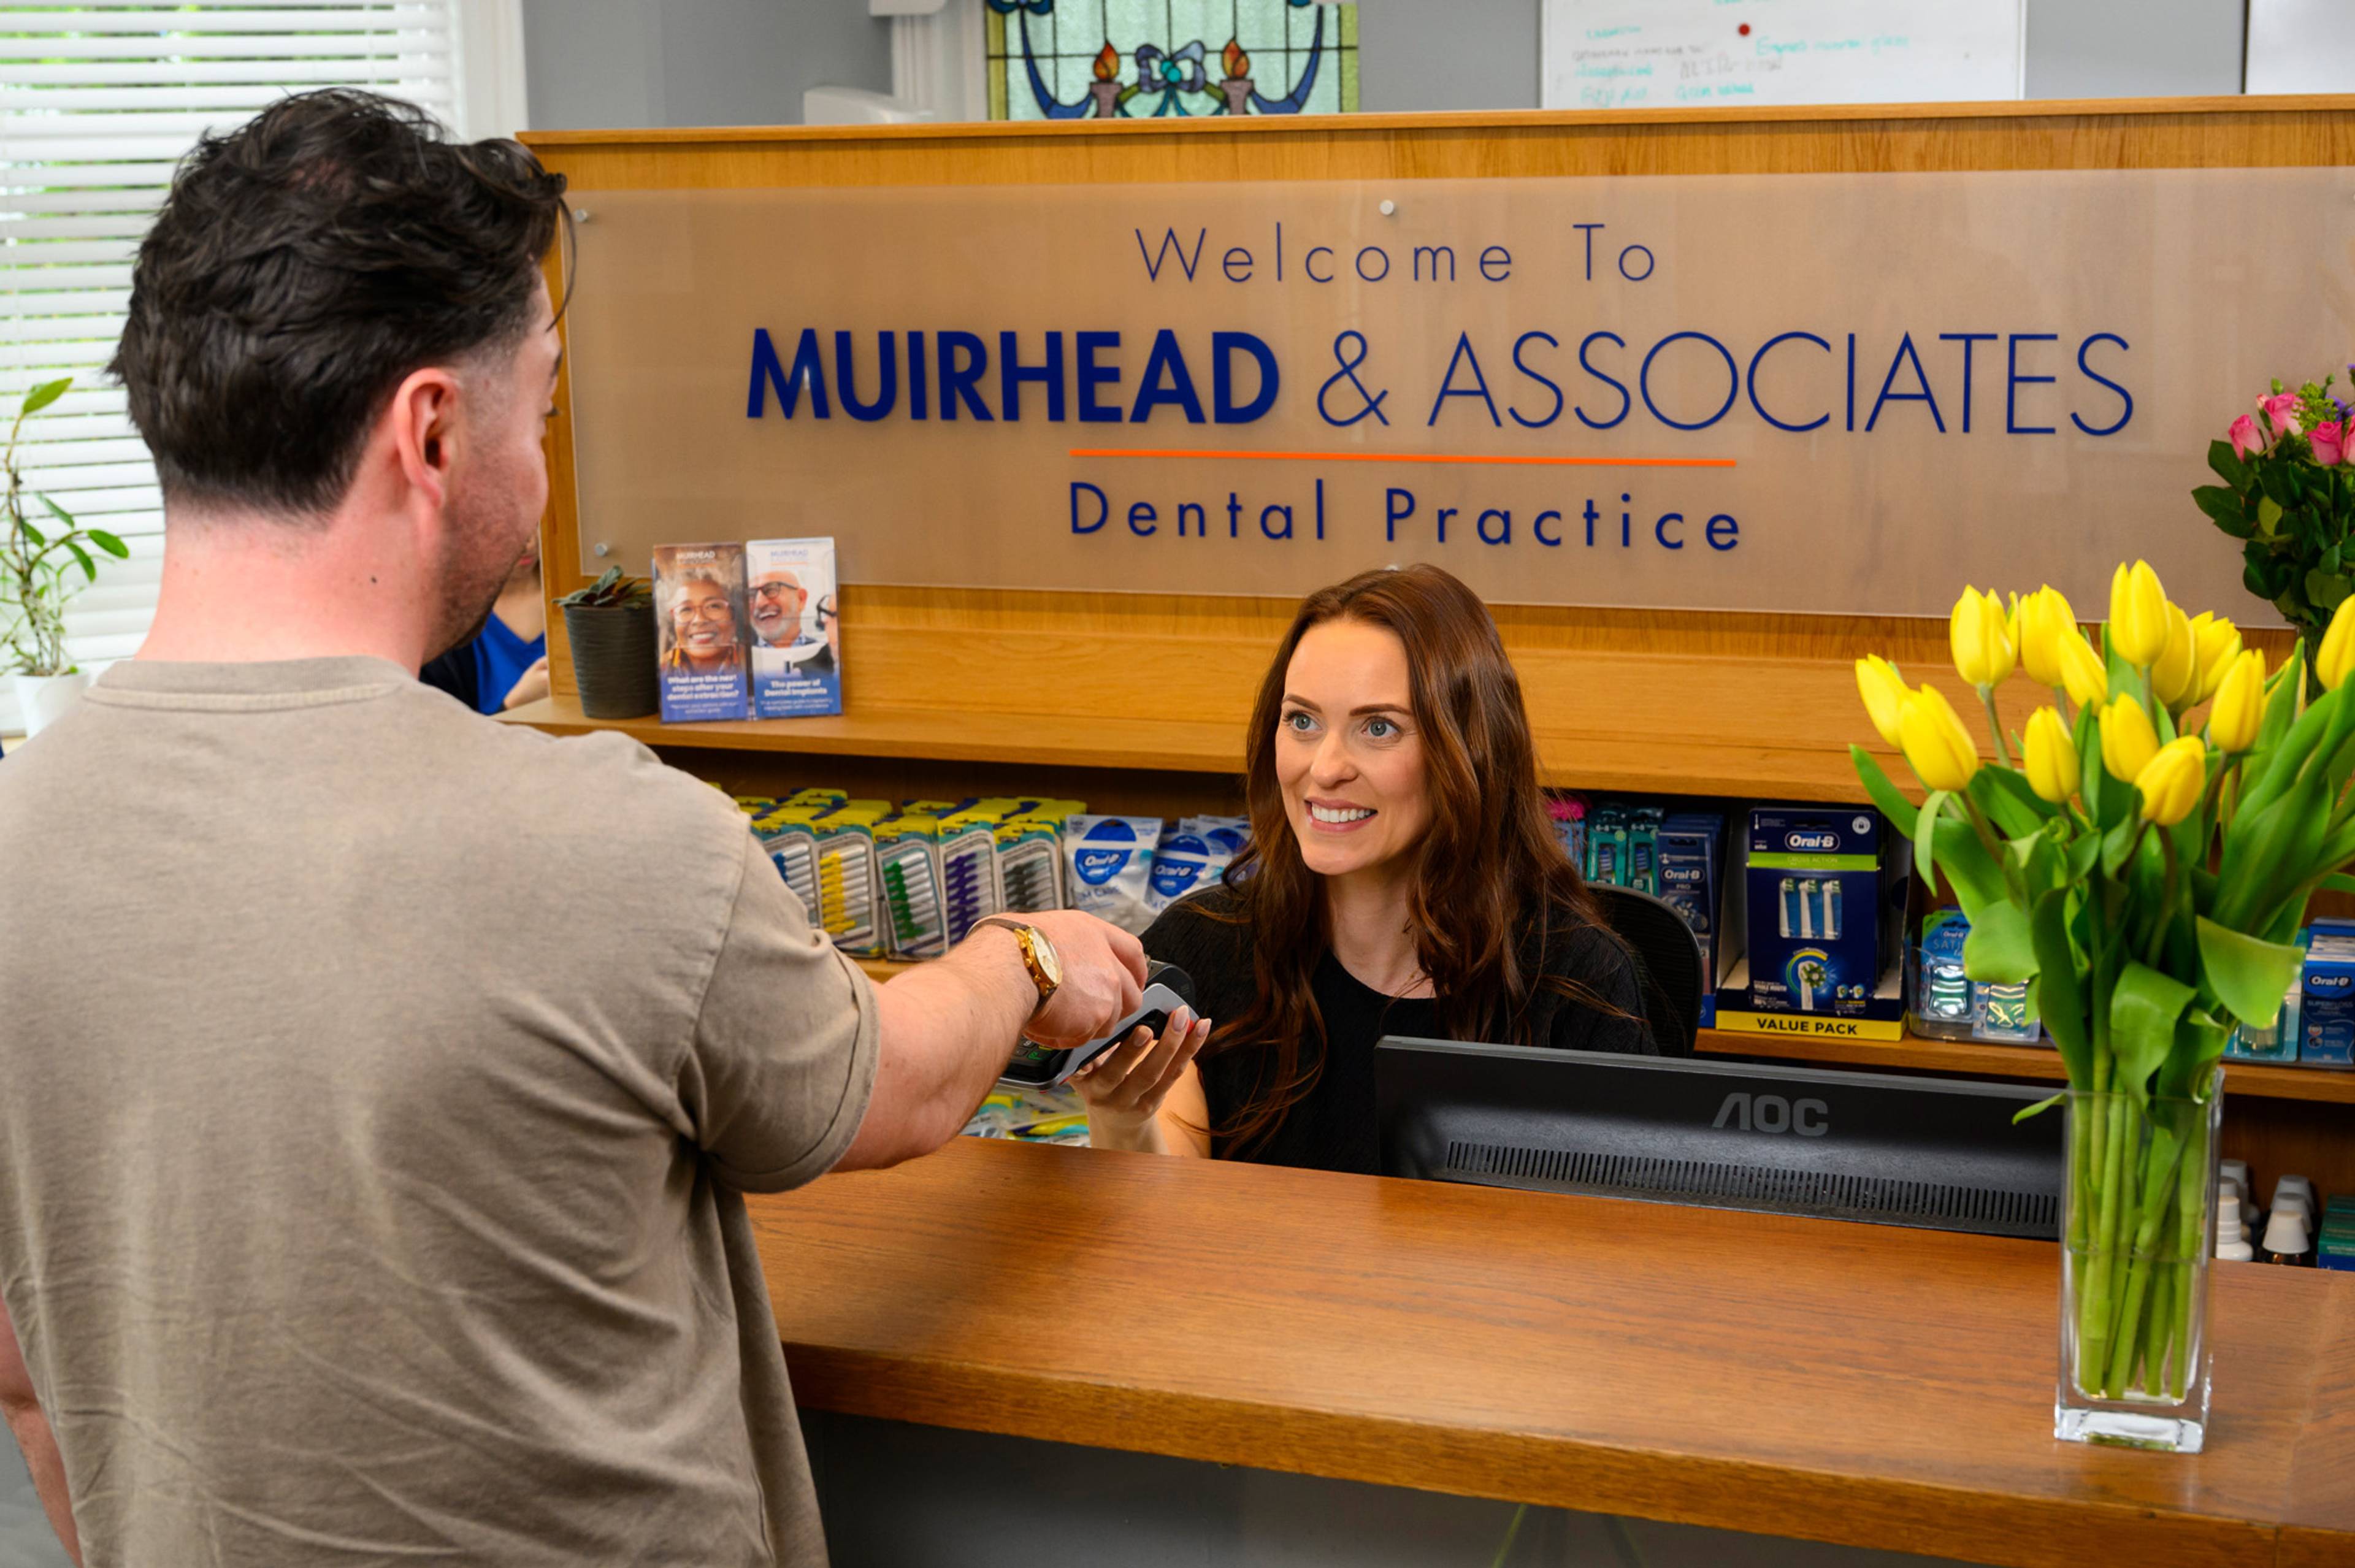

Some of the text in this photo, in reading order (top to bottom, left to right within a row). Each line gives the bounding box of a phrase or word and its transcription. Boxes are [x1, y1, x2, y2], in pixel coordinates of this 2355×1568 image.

[1136, 224, 1655, 283] Welcome To
[747, 329, 2134, 437] MUIRHEAD & ASSOCIATES
[1071, 479, 1739, 552] Dental Practice
[668, 676, 690, 684] What
[787, 679, 811, 690] power
[813, 678, 821, 686] of
[672, 685, 694, 694] steps
[715, 683, 733, 692] your
[764, 688, 791, 697] Dental
[1789, 835, 1835, 848] Oral-B
[1084, 853, 1121, 866] Oral-B
[1154, 864, 1192, 877] Oral-B
[1664, 870, 1701, 880] Oral-B
[2310, 976, 2349, 987] Oral-B
[1757, 1018, 1857, 1035] VALUE PACK
[1712, 1092, 1829, 1136] AOC
